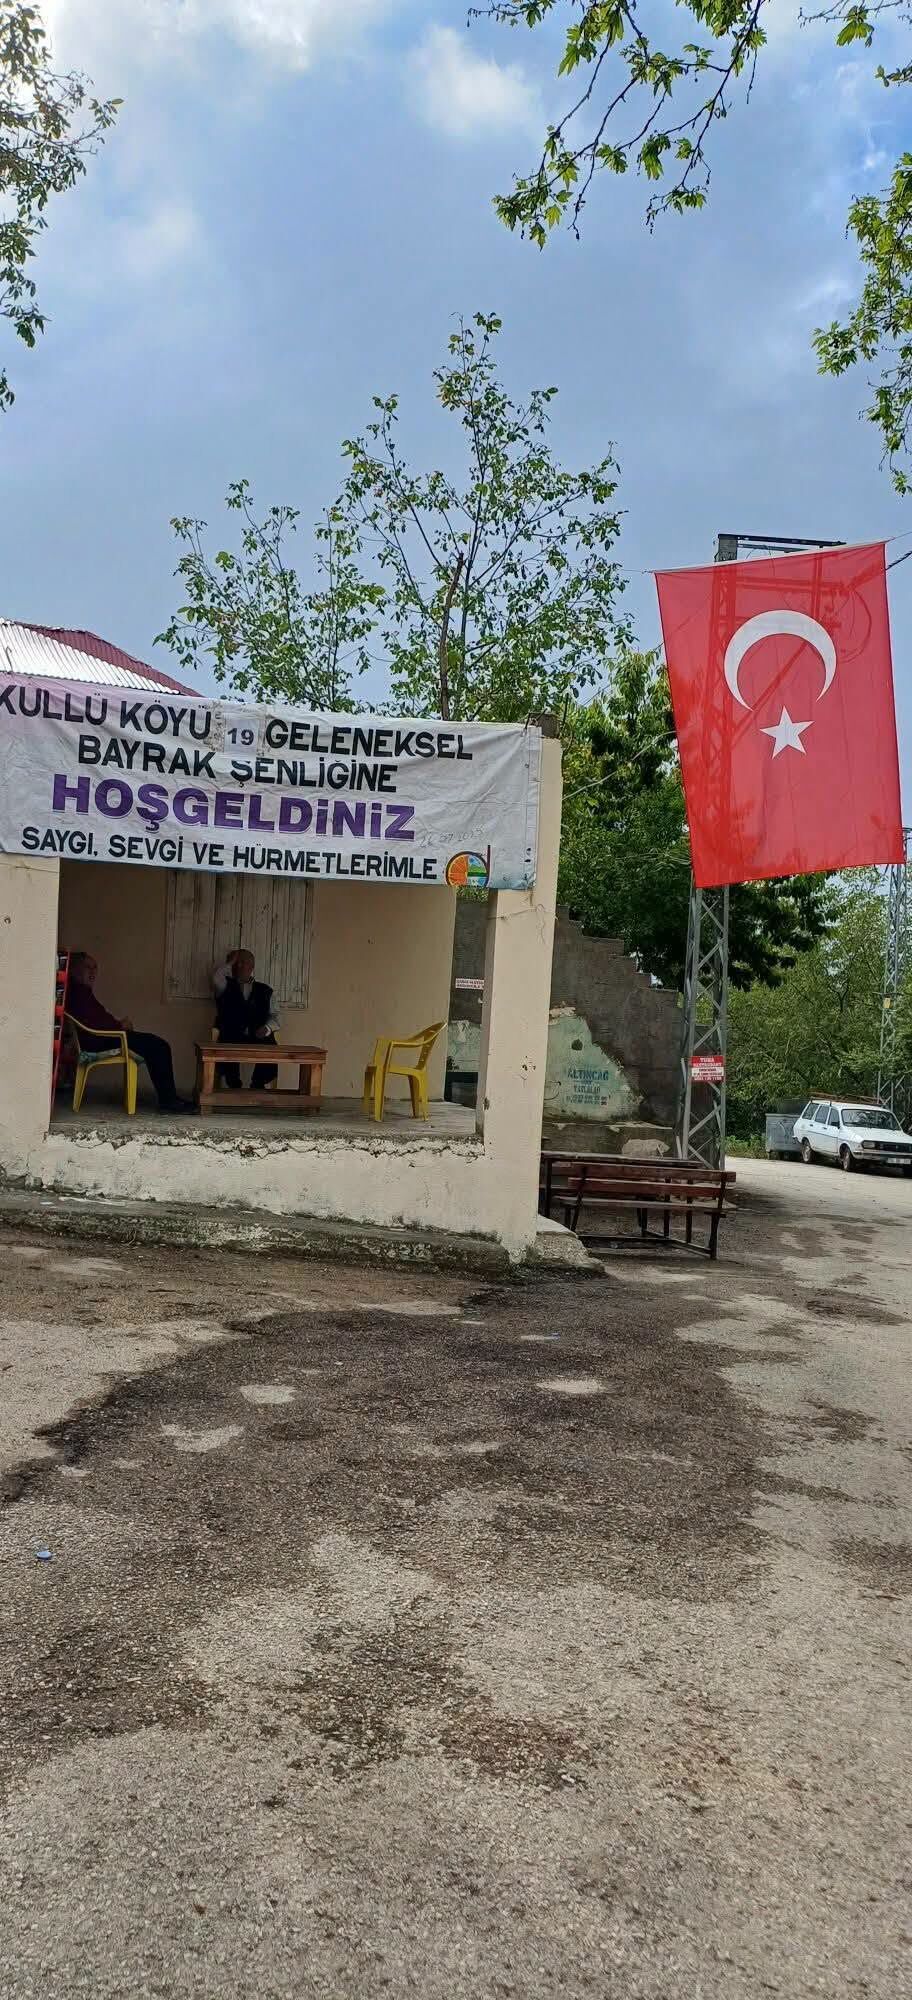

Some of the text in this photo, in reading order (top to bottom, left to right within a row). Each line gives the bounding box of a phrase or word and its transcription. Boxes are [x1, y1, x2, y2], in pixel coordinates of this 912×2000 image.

[119, 699, 212, 740] KÖYÜ
[227, 727, 255, 746] 19
[265, 718, 473, 760] GELENEKSEL
[78, 735, 398, 793] BAYRAK ŞENLİĞİNE
[108, 835, 184, 863] SEVGİ
[193, 842, 225, 866] VE
[233, 843, 438, 880] HÜRMETLERİMLE
